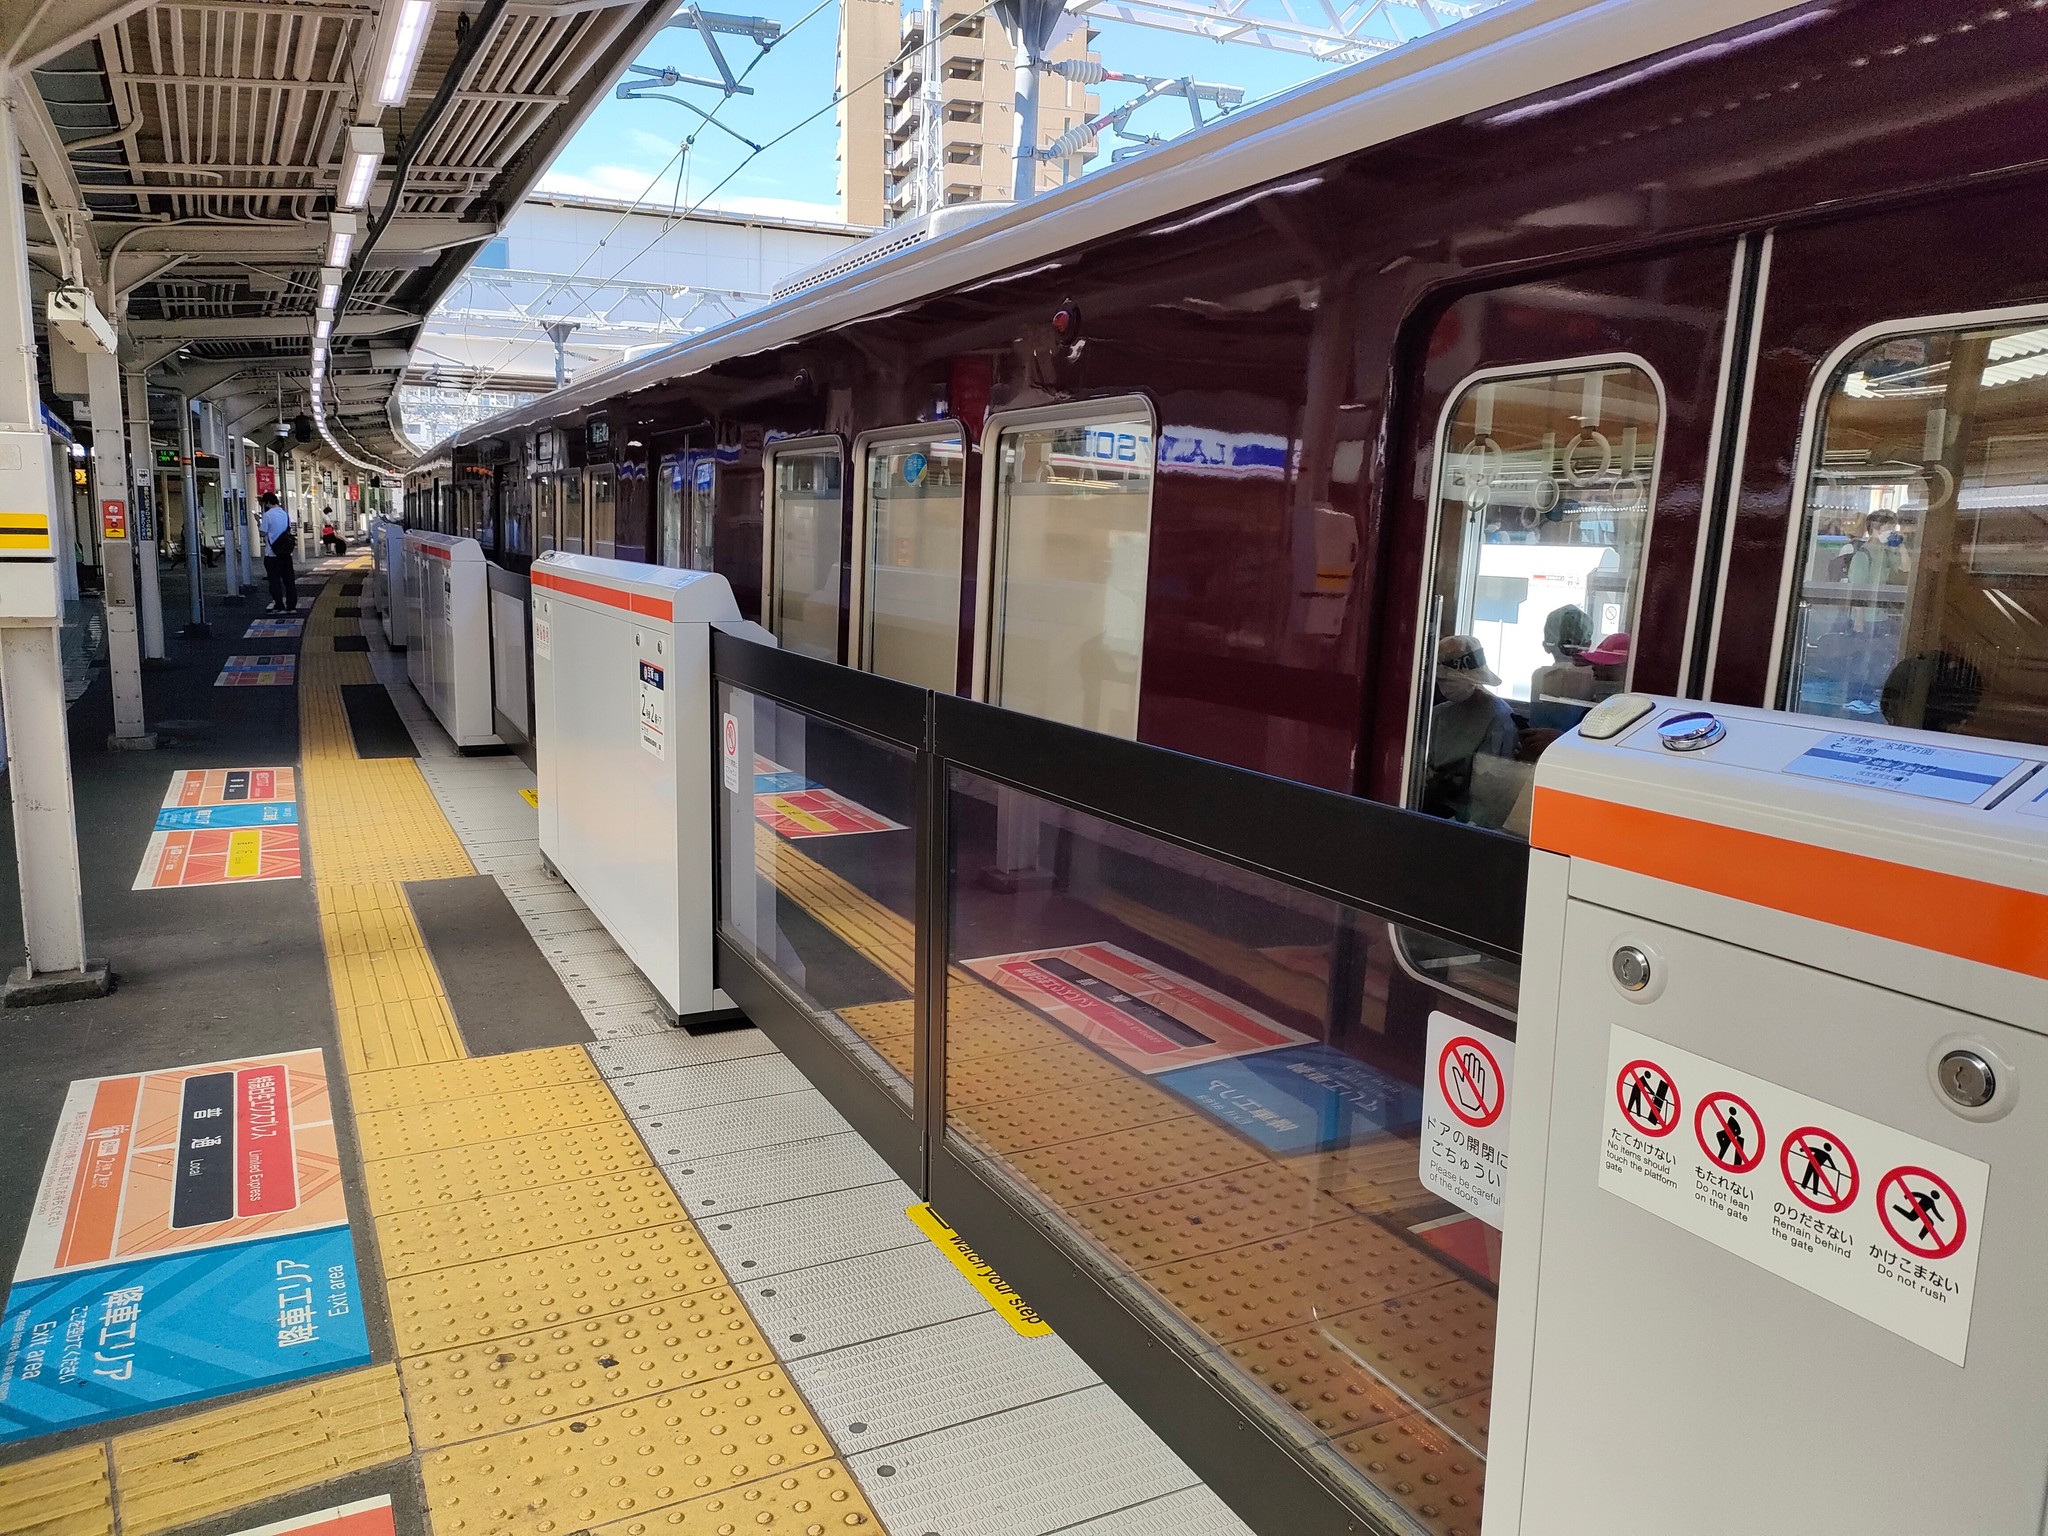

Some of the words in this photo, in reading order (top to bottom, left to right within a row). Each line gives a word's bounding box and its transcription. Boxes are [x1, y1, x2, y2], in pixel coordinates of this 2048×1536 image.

[247, 1075, 277, 1140] 特急日生エクスプレス
[1427, 1115, 1508, 1170] ドアの開閉に
[1607, 1139, 1619, 1151] No
[1620, 1145, 1642, 1161] items
[1643, 1157, 1670, 1175] should
[1611, 1127, 1677, 1165] たてかけない
[189, 1158, 204, 1177] Local
[249, 1150, 263, 1173] Limited
[1431, 1139, 1501, 1187] ごちゅうい
[1605, 1161, 1623, 1174] gate
[1606, 1150, 1629, 1166] touch
[1630, 1160, 1643, 1173] the
[1644, 1169, 1678, 1190] platform
[247, 1173, 264, 1202] Express
[1429, 1172, 1438, 1183] of
[1439, 1177, 1453, 1191] the
[1454, 1186, 1479, 1206] doors
[1430, 1160, 1457, 1182] Please
[1459, 1176, 1470, 1189] be
[1472, 1184, 1501, 1206] careful
[1694, 1165, 1755, 1201] もたれない
[1696, 1180, 1709, 1193] Do
[1711, 1189, 1727, 1201] not
[1729, 1195, 1750, 1212] lean
[1694, 1192, 1707, 1203] on
[1709, 1198, 1724, 1211] the
[1726, 1207, 1748, 1222] gate
[1773, 1201, 1854, 1246] のりださない
[1772, 1227, 1788, 1241] the
[1790, 1237, 1814, 1253] gate
[1773, 1215, 1811, 1240] Remain
[1814, 1234, 1851, 1259] behind
[329, 1264, 345, 1290] area
[949, 1235, 987, 1269] watch
[977, 1267, 1016, 1295] your
[1009, 1298, 1042, 1324] step
[1869, 1244, 1959, 1294] かけこまない
[1877, 1263, 1894, 1278] Do
[1897, 1275, 1916, 1289] not
[1920, 1285, 1947, 1303] rush
[14, 1309, 31, 1331] Please
[276, 1259, 319, 1348] 降車エリア
[328, 1289, 350, 1316] Exit
[9, 1332, 25, 1351] leave
[30, 1321, 57, 1347] Exit
[59, 1305, 88, 1384] ここを空けてください
[93, 1285, 144, 1381] 降車エリア
[21, 1350, 46, 1380] area
